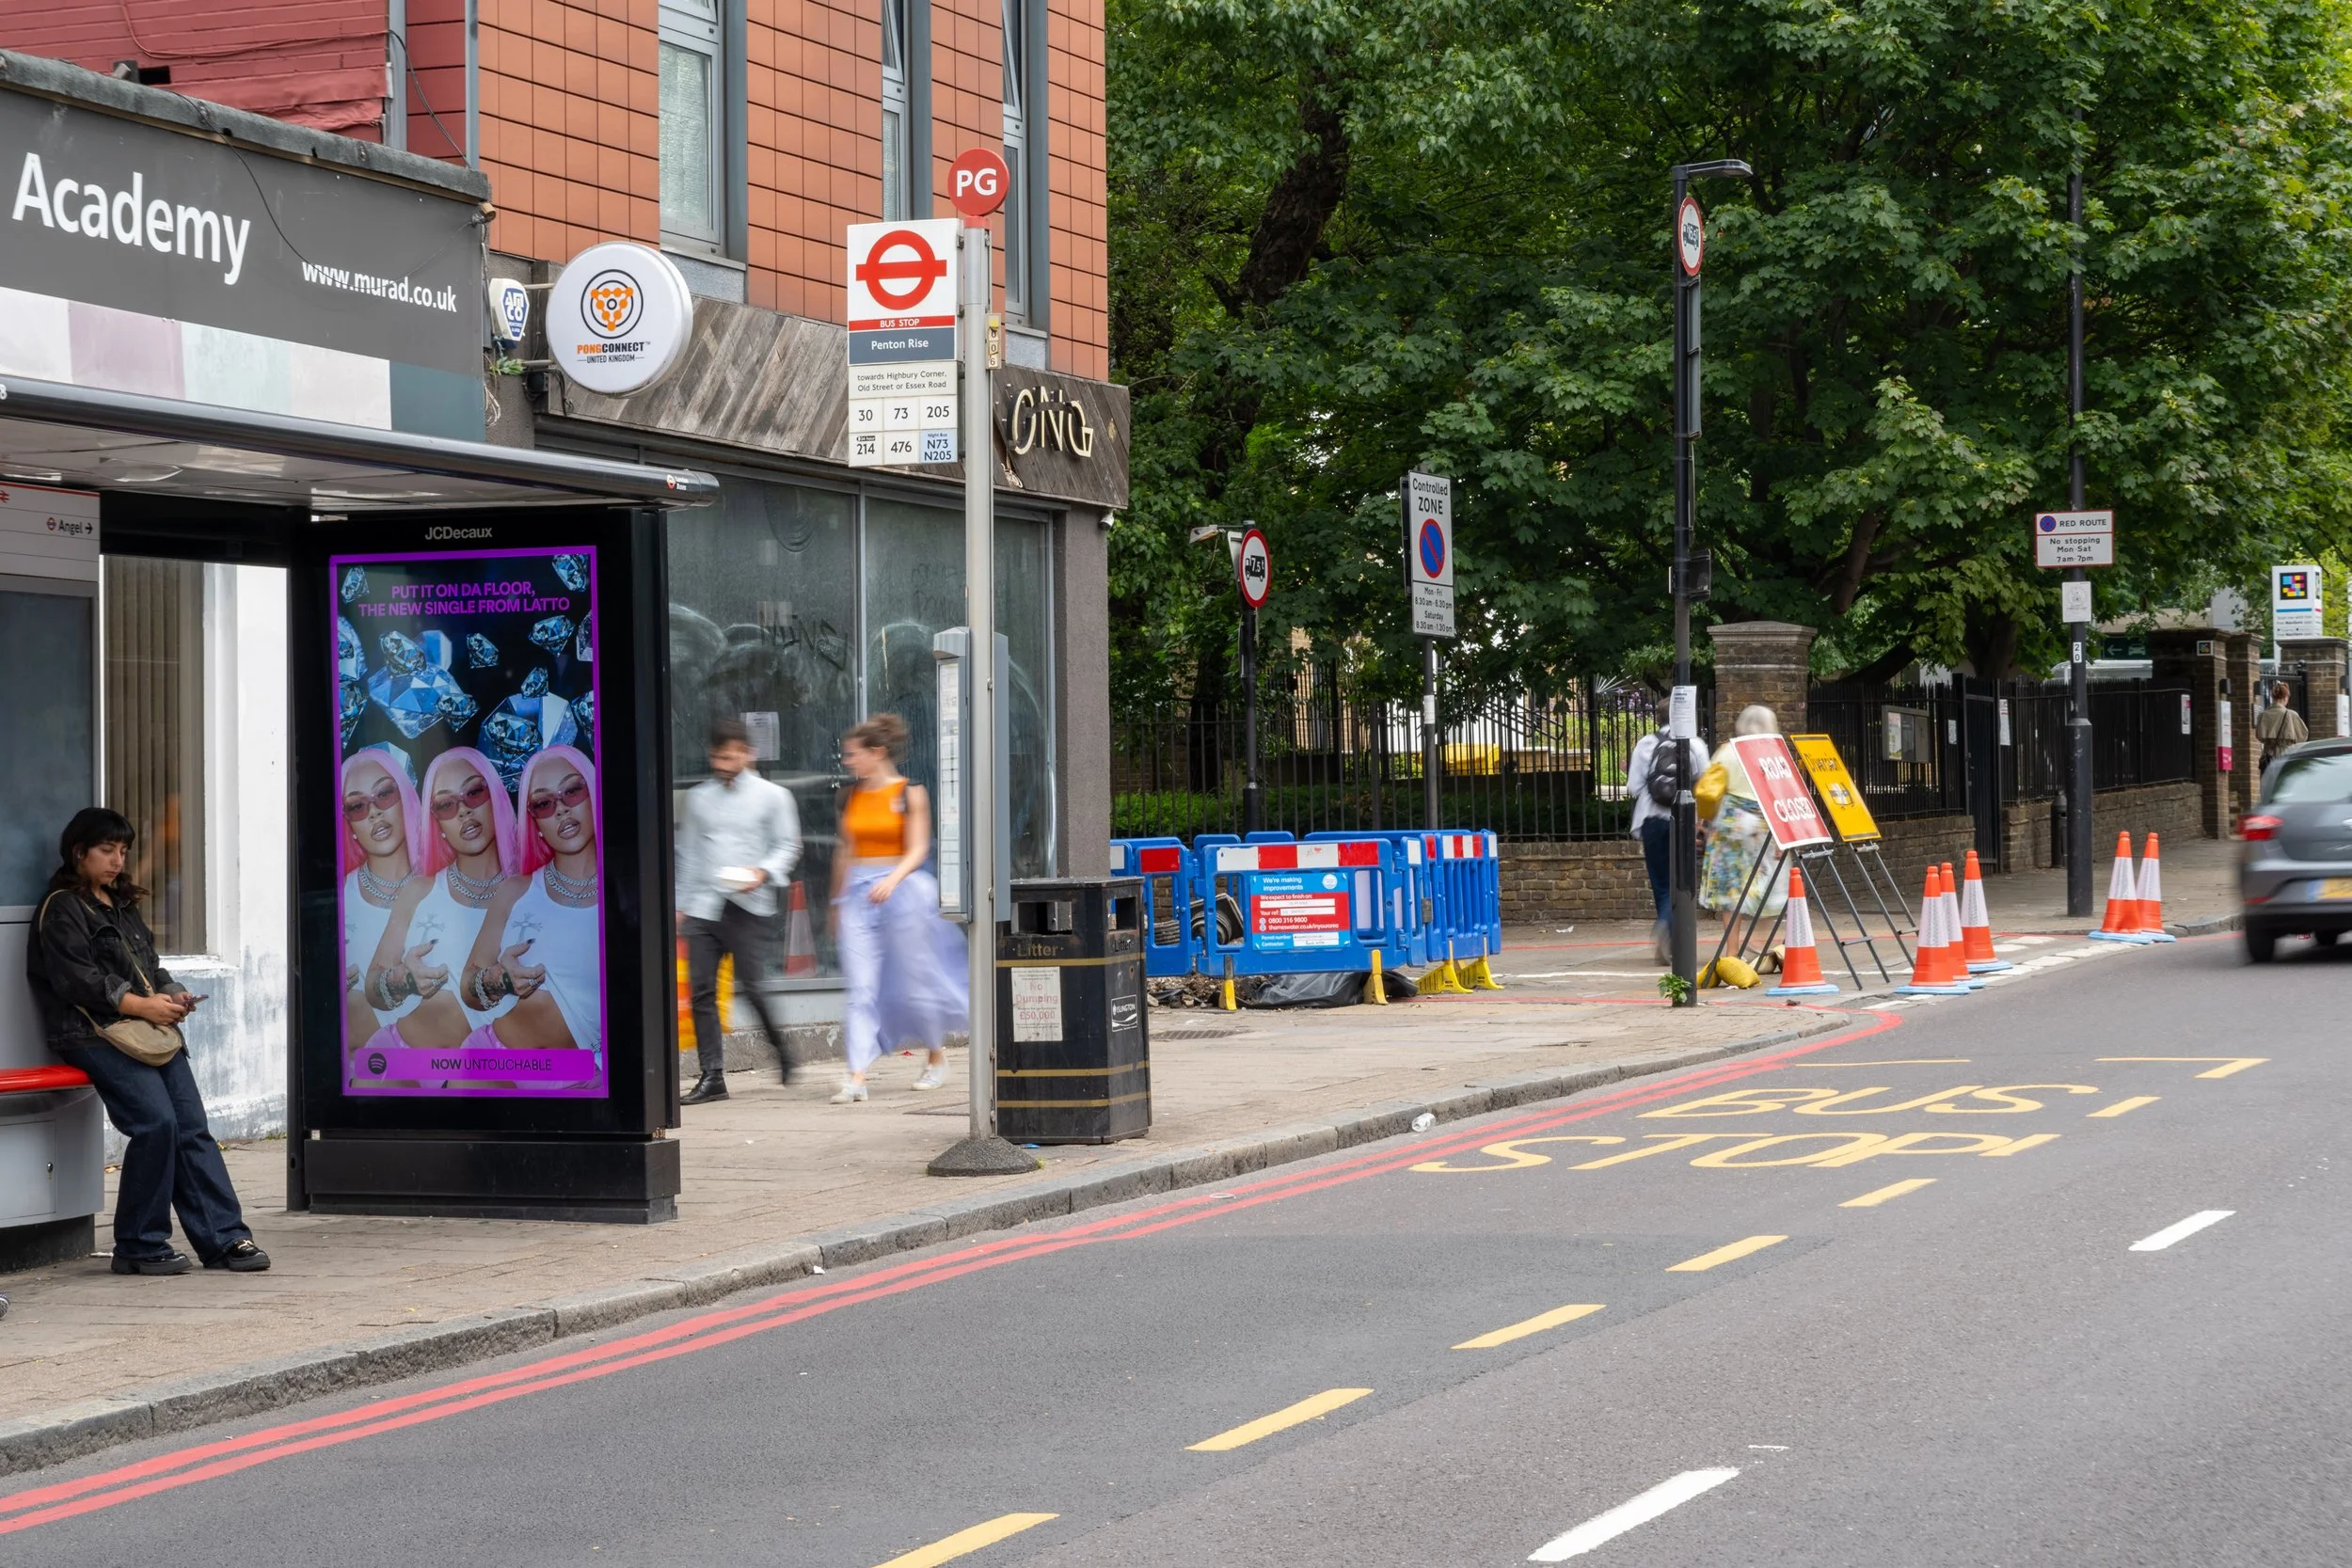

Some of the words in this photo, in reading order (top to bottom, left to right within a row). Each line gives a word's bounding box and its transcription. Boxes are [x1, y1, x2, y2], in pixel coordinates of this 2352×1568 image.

[957, 167, 996, 197] PG
[12, 151, 250, 286] Academy
[302, 261, 457, 312] www.murad.co.uk
[899, 318, 919, 326] STOP
[871, 340, 905, 350] Penton
[908, 339, 930, 348] Rise
[586, 355, 607, 363] UNITED
[609, 354, 635, 362] KINGDOM
[857, 372, 884, 381] towards
[886, 372, 918, 381] Highbury
[858, 409, 873, 421] 30
[894, 407, 909, 420] 73
[927, 405, 949, 418] 205
[856, 443, 875, 454] 214
[890, 441, 913, 452] 476
[927, 439, 948, 449] N73
[924, 451, 952, 461] N205
[1412, 478, 1448, 496] Controlled
[1419, 497, 1443, 515] ZONE
[58, 519, 83, 535] Angel
[424, 527, 493, 540] JCDecaux
[391, 585, 419, 598] PUT
[421, 585, 434, 598] IT
[436, 583, 459, 597] ON
[461, 583, 482, 596] DA
[484, 581, 535, 597] FLOOR,
[1424, 587, 1435, 595] Mon
[358, 603, 385, 617] THE
[389, 602, 422, 616] NEW
[425, 600, 475, 615] SINGLE
[478, 598, 521, 613] FROM
[524, 597, 570, 611] LATTO
[1415, 596, 1425, 606] 8.30
[1435, 599, 1445, 609] 6.30
[1424, 610, 1444, 622] Saturday
[1416, 621, 1426, 629] 8.30
[1758, 756, 1792, 780] ROAD
[1773, 797, 1816, 823] CLOSED
[1281, 876, 1302, 884] making
[1017, 943, 1058, 957] Litter
[1115, 940, 1131, 952] Litter
[1029, 982, 1043, 991] No
[1016, 994, 1058, 1005] Dumping
[431, 1059, 461, 1069] NOW
[464, 1059, 552, 1070] UNTOUCHABLE
[1635, 1085, 2100, 1118] BUS
[1409, 1132, 2063, 1172] STOP
